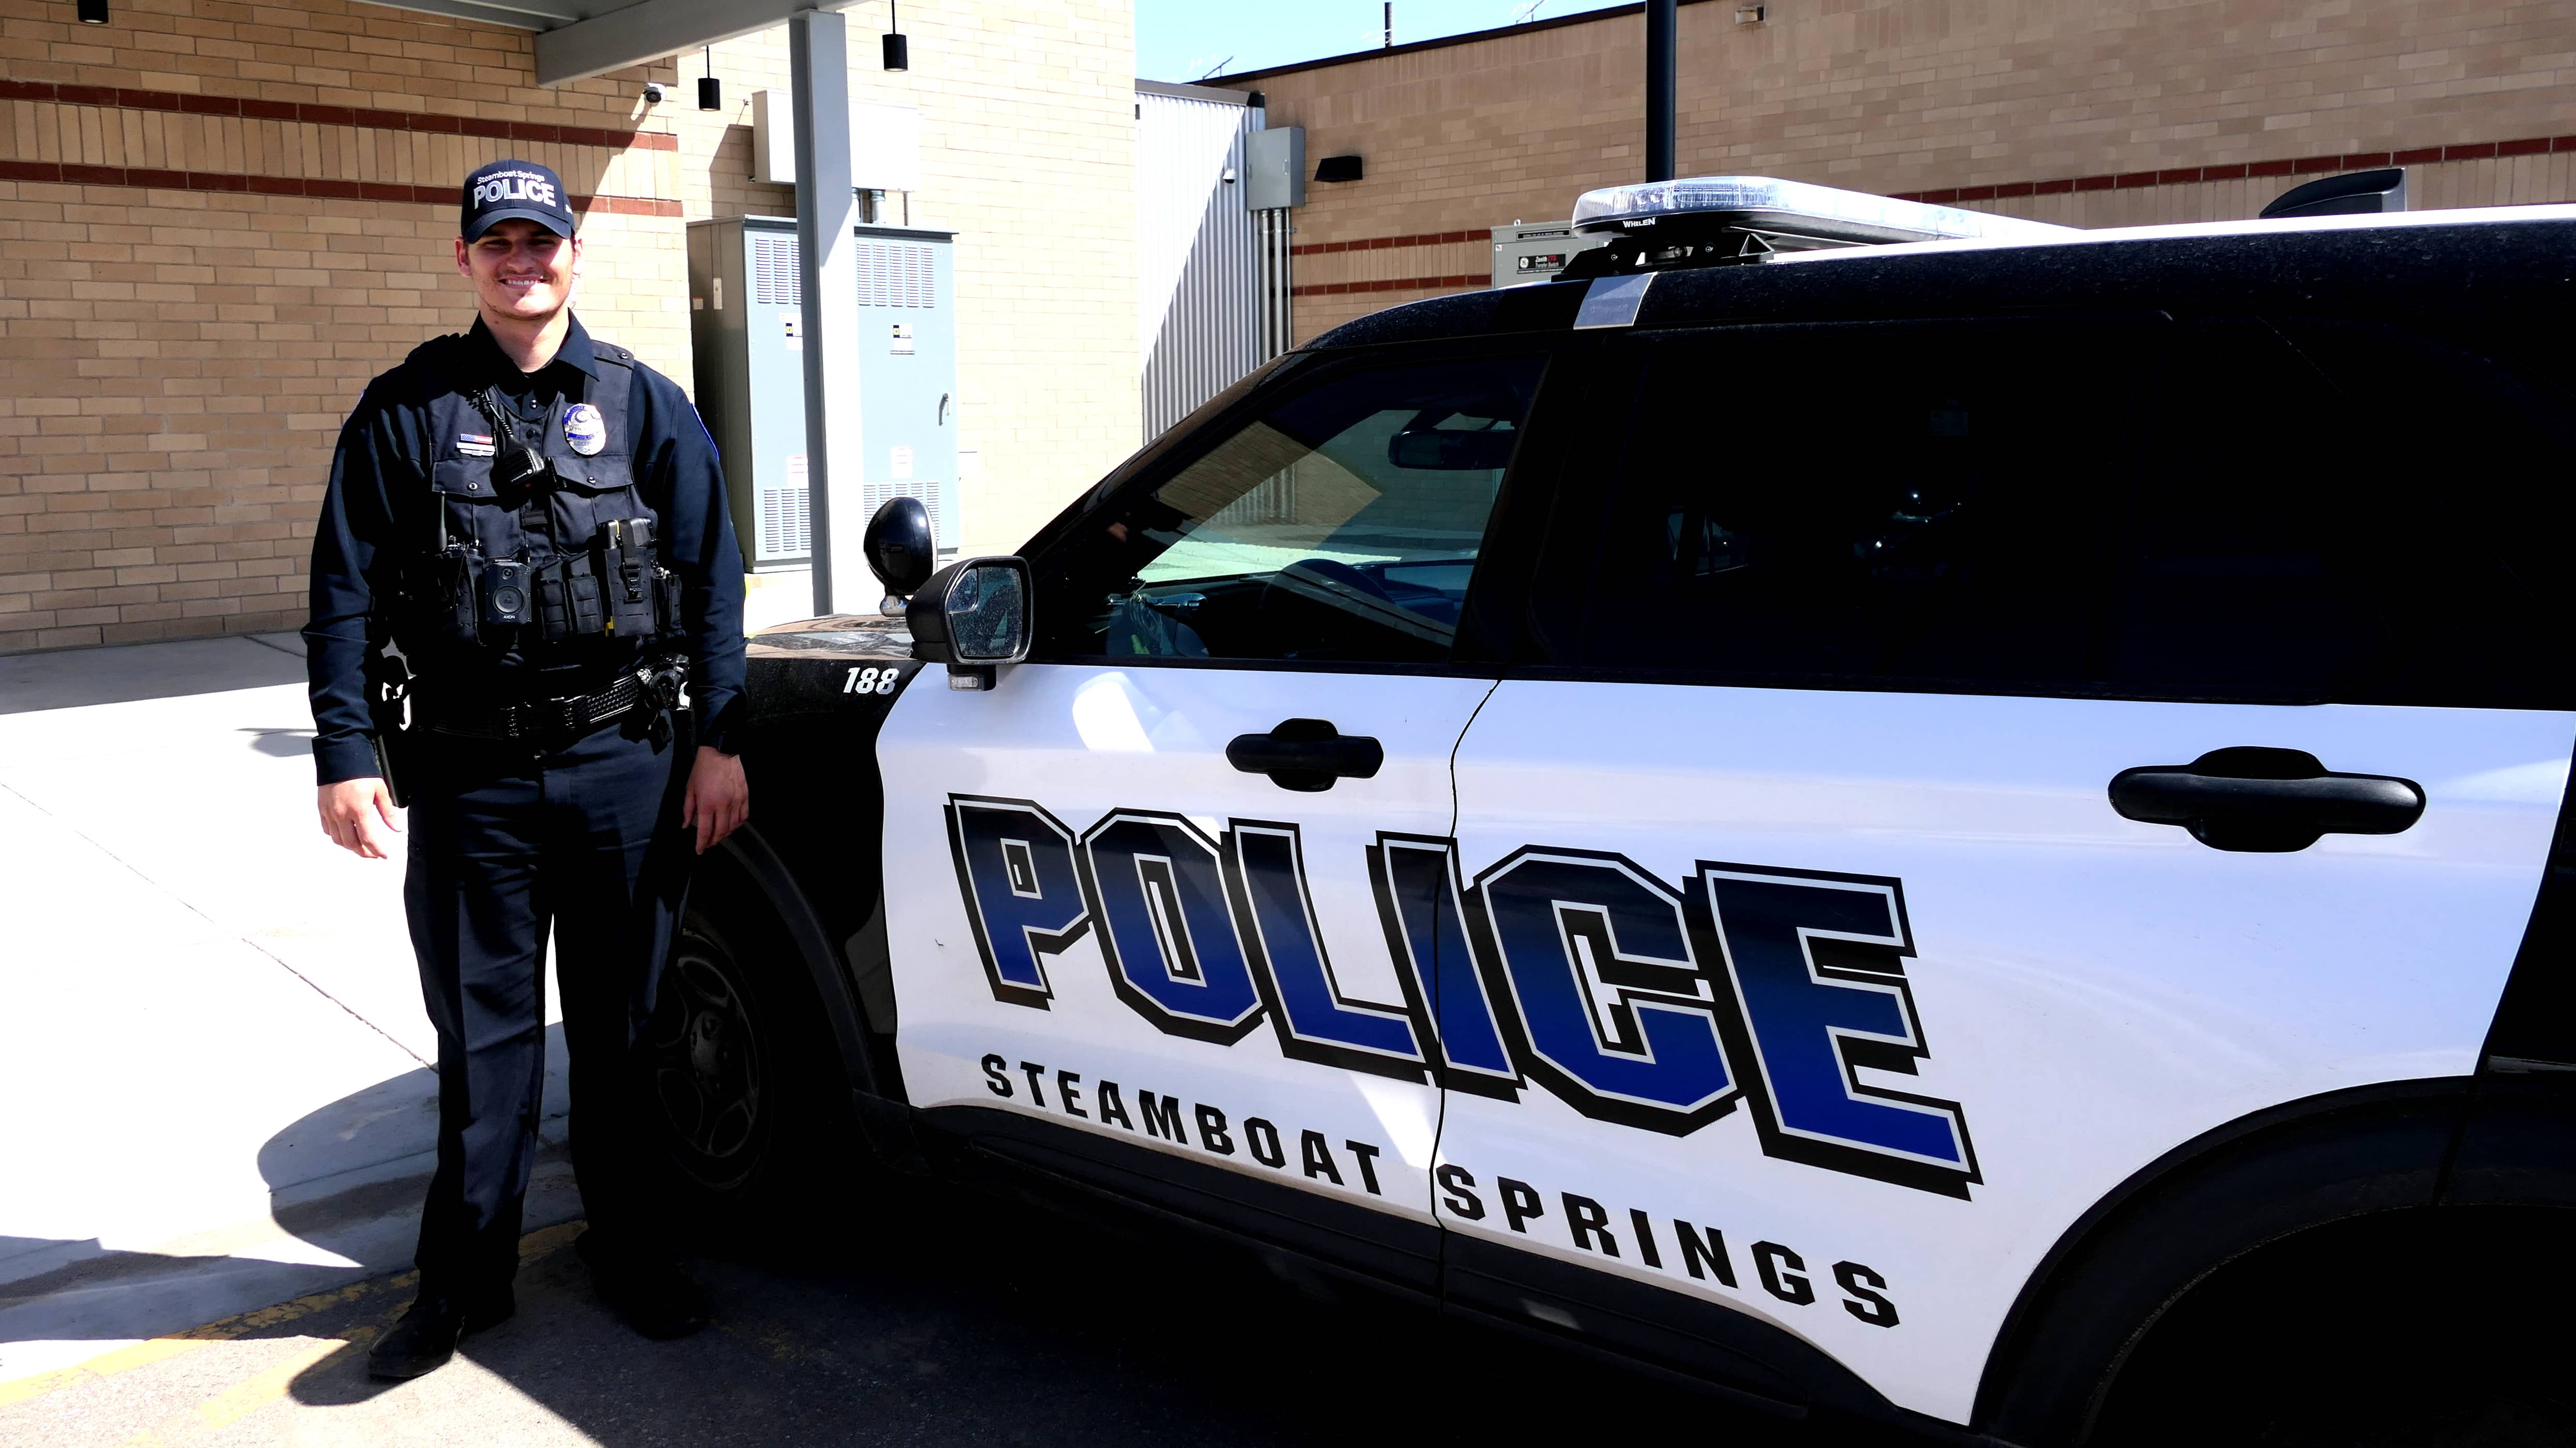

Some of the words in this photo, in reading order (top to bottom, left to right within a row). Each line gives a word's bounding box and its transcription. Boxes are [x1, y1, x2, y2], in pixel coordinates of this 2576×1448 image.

[477, 170, 517, 184] Steamboat
[517, 171, 545, 182] Springs
[473, 178, 556, 210] POLICE
[1622, 217, 1657, 228] WHELEN
[843, 667, 899, 694] 188
[942, 792, 1984, 1202] POLICE
[981, 1053, 1381, 1196] STEAMBOAT
[1435, 1163, 1900, 1328] SPRINGS
